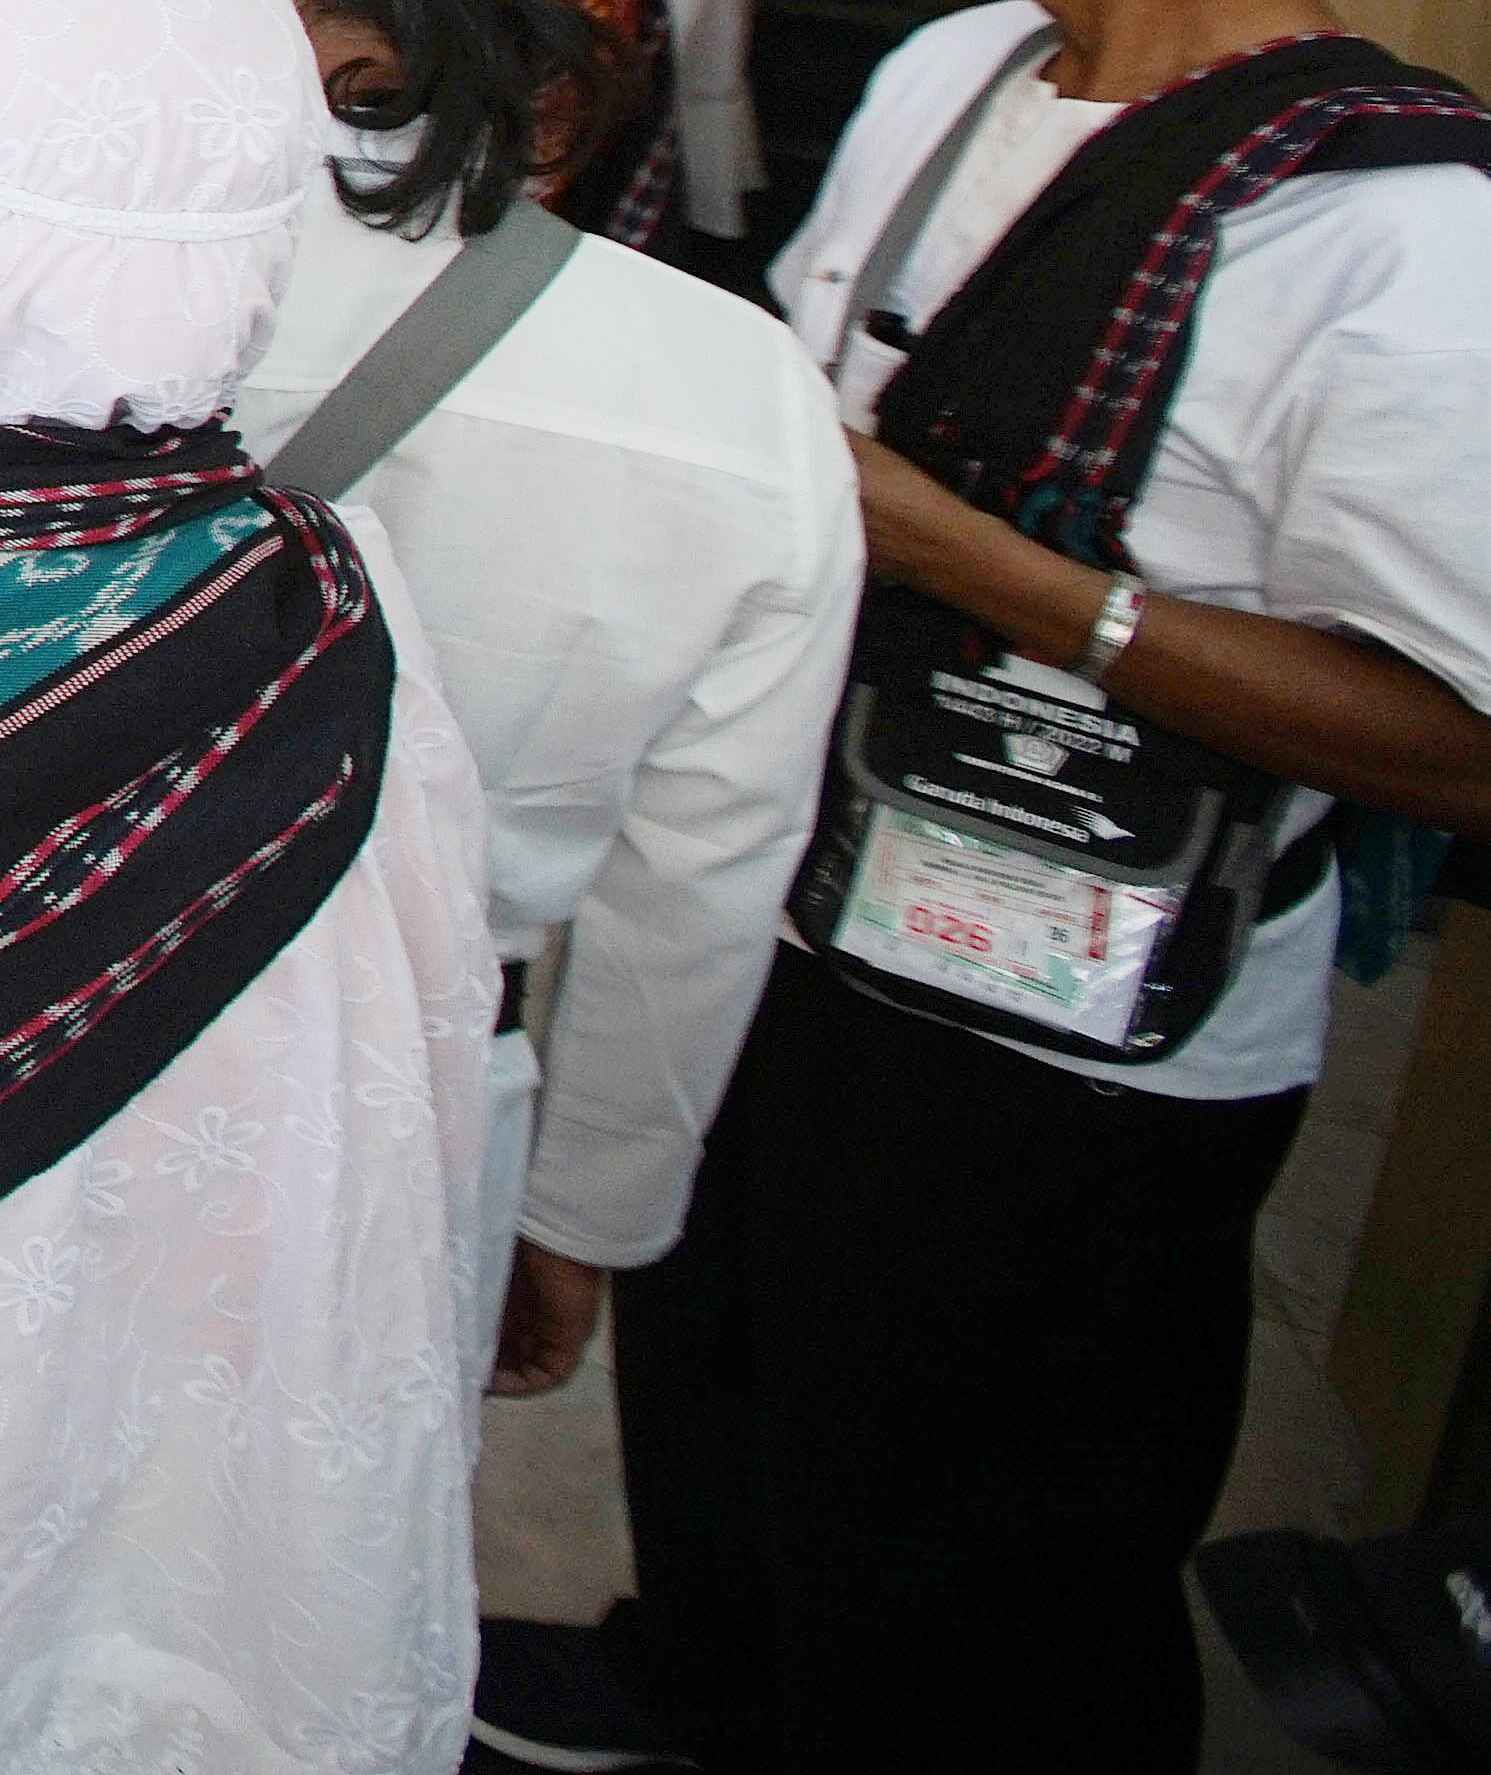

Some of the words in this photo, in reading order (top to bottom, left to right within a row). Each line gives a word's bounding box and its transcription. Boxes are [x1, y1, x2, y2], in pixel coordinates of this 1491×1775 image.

[929, 670, 1142, 747] INDONESIA
[903, 774, 985, 809] Garuda
[989, 796, 1091, 844] Indonesia
